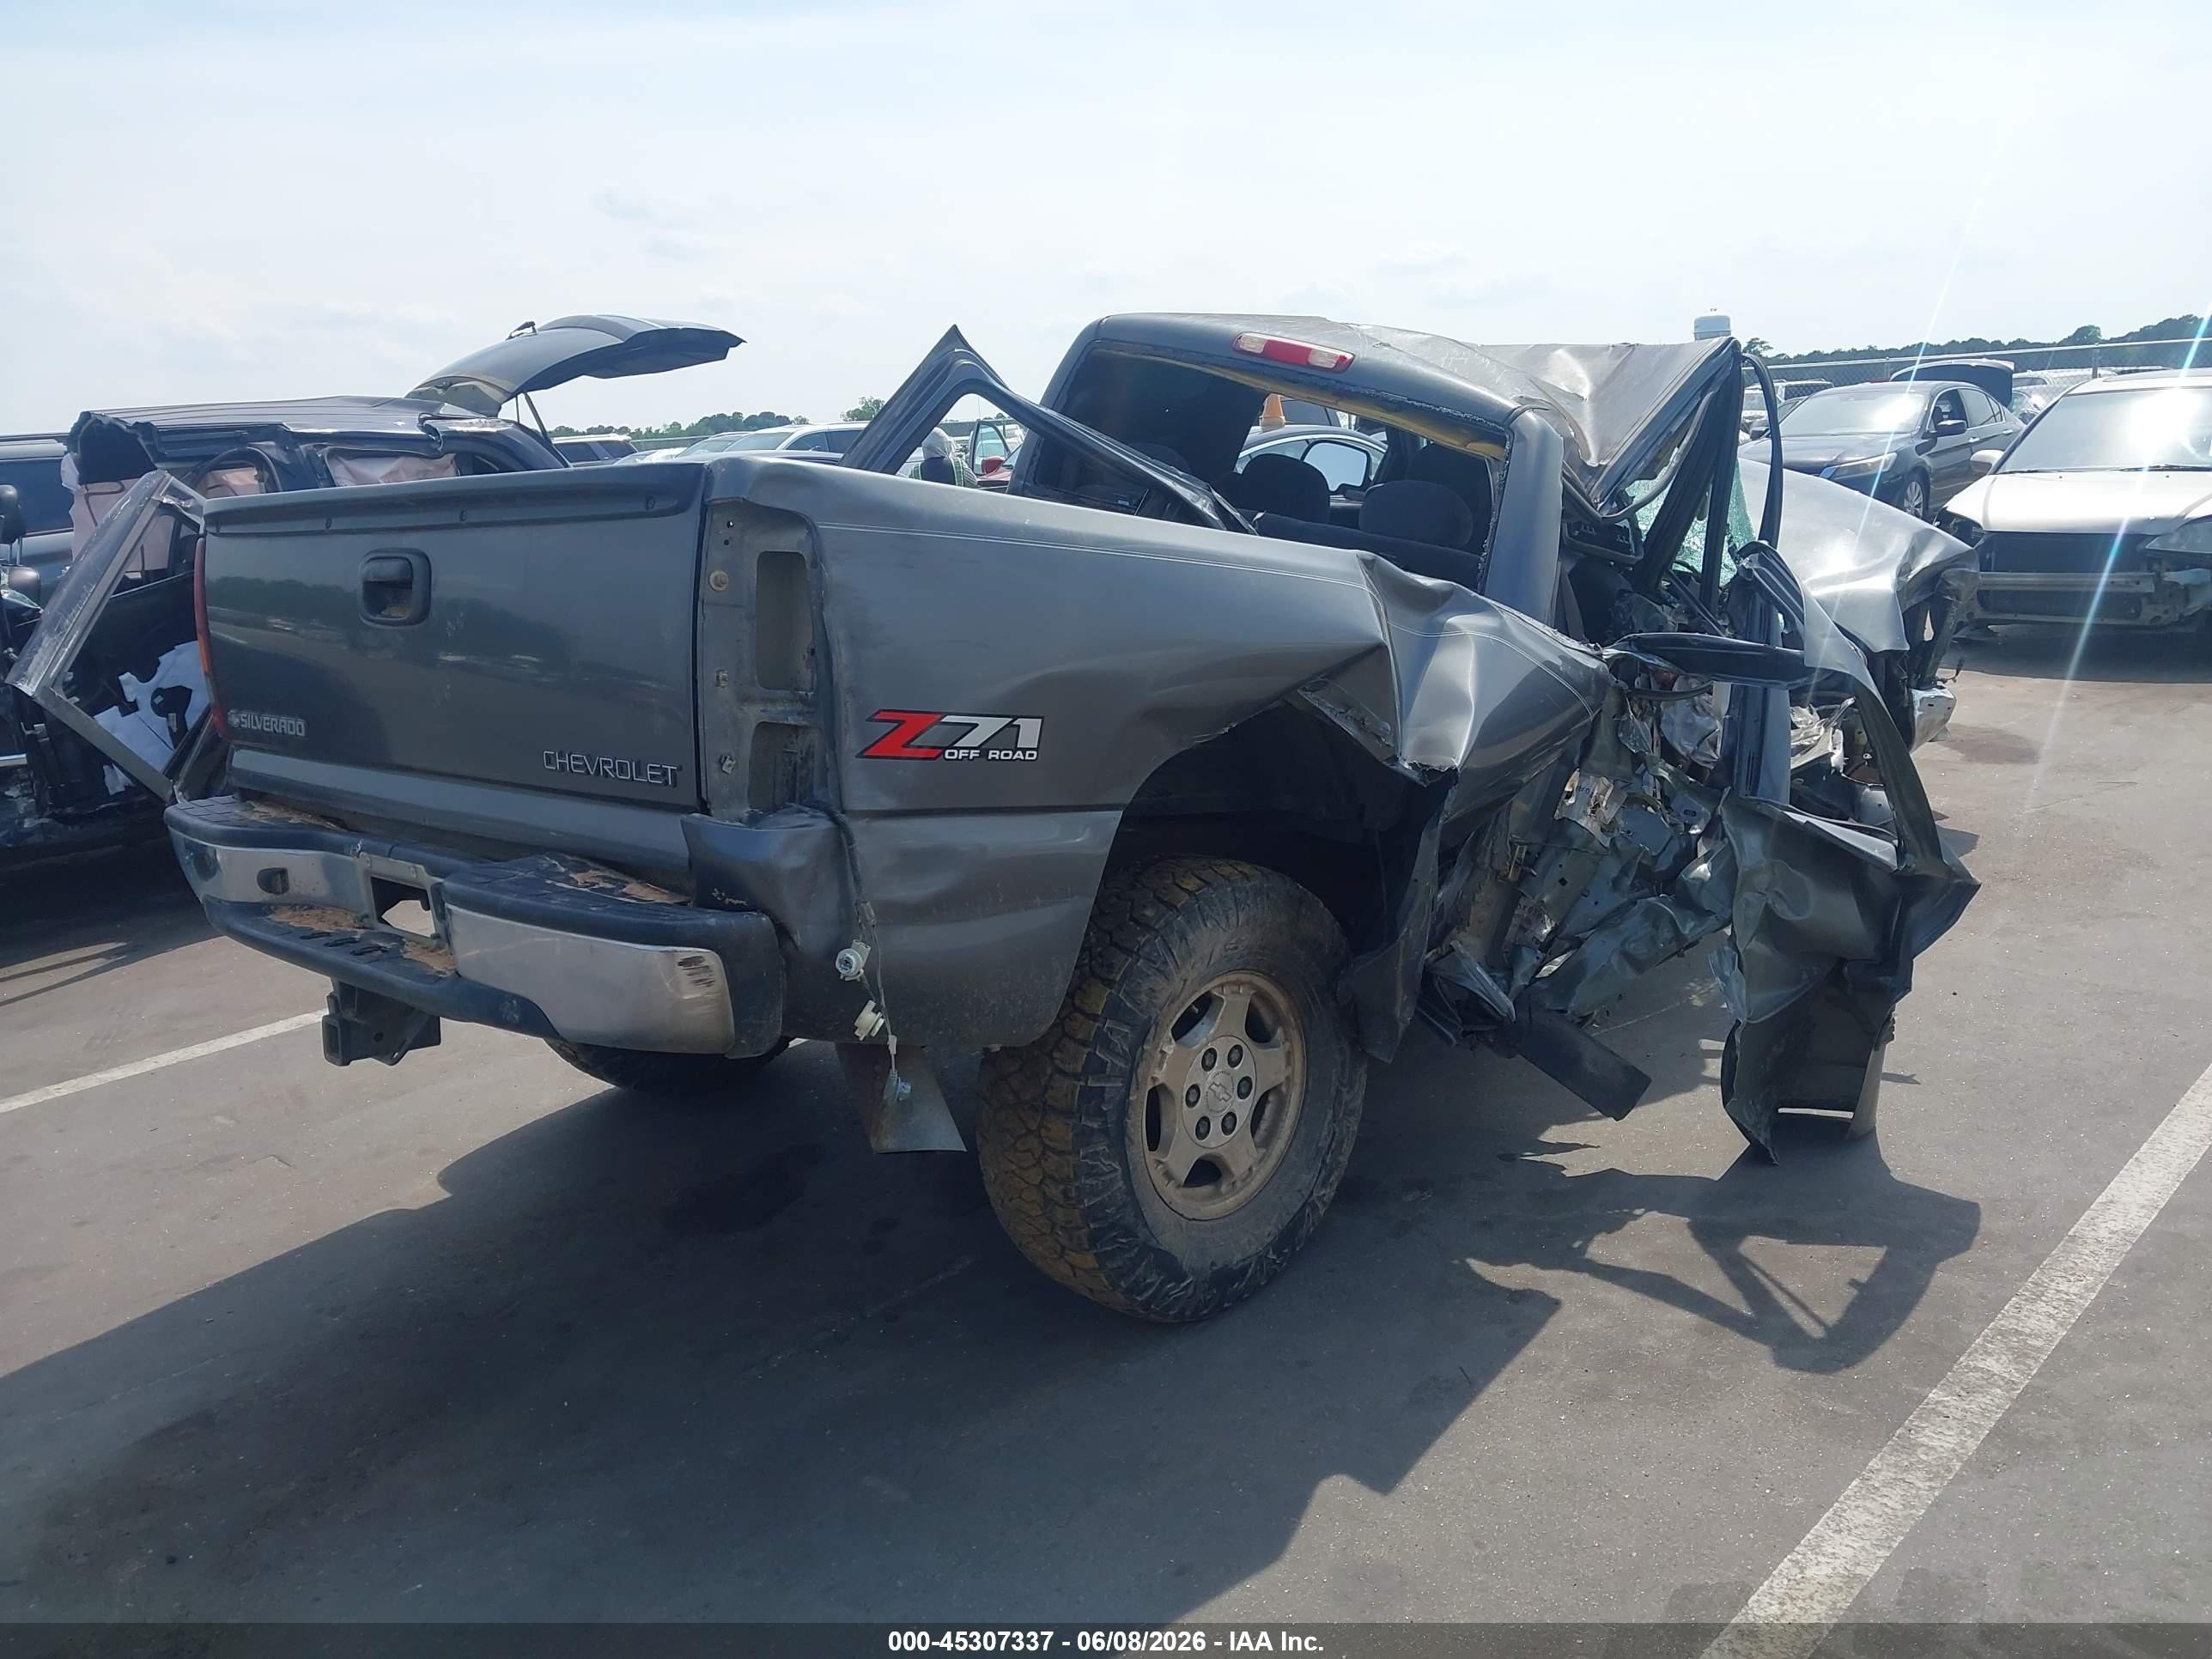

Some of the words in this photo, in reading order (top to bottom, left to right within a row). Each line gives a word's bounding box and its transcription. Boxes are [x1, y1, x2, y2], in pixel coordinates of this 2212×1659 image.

[240, 714, 306, 736] SILVERADO
[859, 709, 1044, 760] Z71
[543, 750, 678, 785] CHEVROLET
[944, 749, 980, 761] OFF
[988, 749, 1037, 761] ROAD
